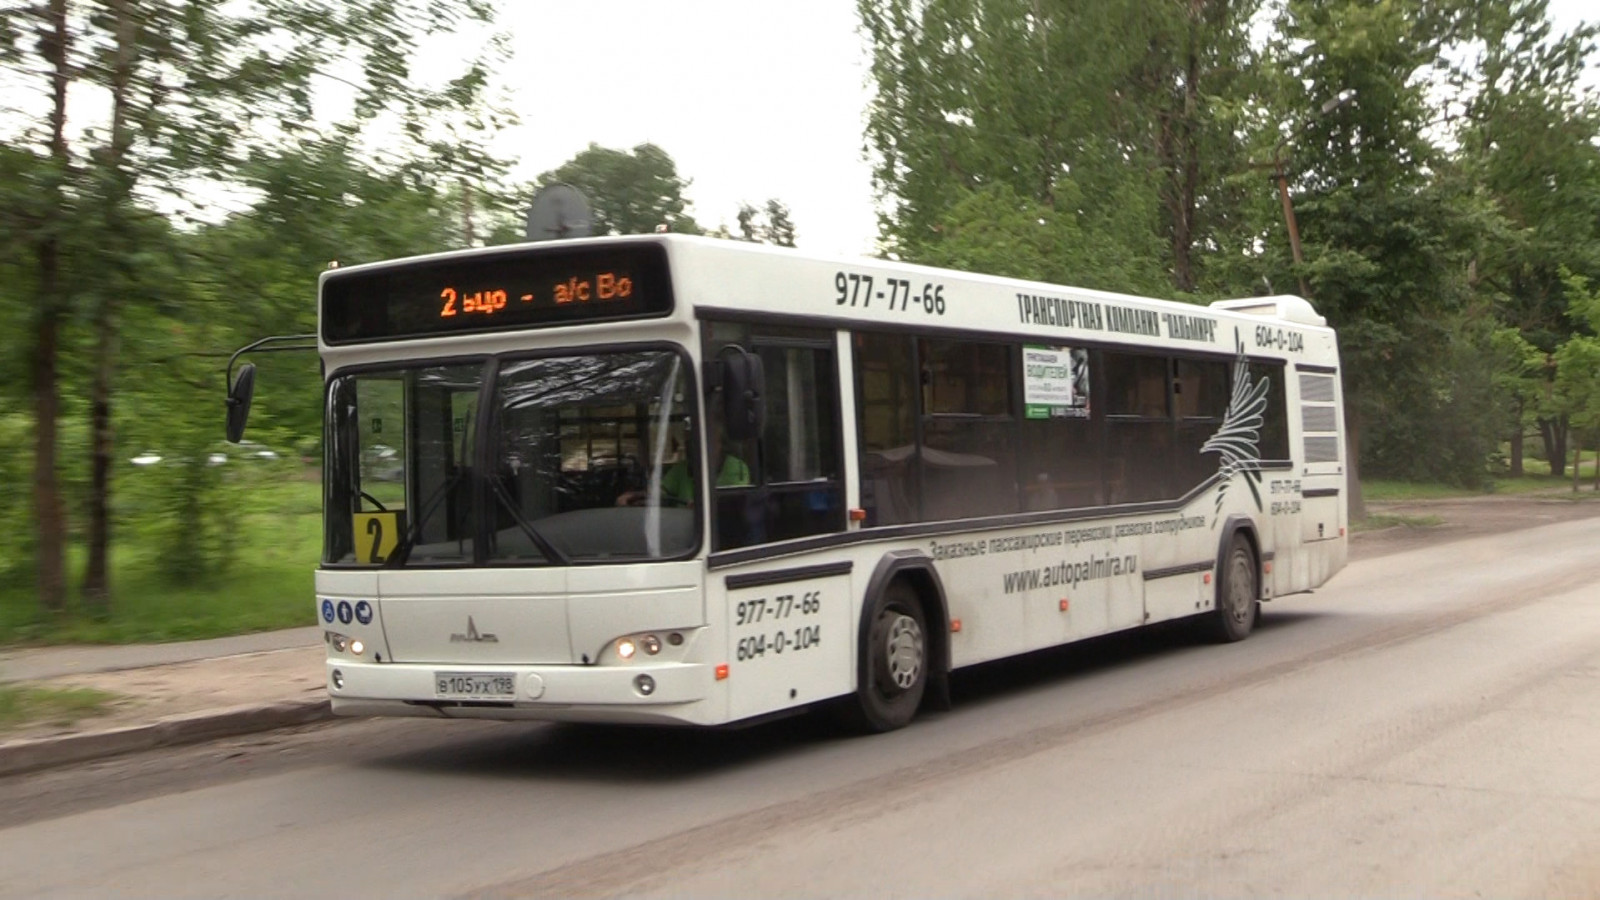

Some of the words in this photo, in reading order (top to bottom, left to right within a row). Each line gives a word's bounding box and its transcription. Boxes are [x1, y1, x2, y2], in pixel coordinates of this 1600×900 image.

[440, 287, 457, 317] 2
[835, 271, 946, 316] 977-77-66
[1016, 292, 1104, 331] ТРАНСПОРТНАЯ
[1105, 304, 1161, 337] КОМПАНИЯ
[1256, 325, 1304, 353] 604-0-104
[367, 517, 385, 563] 2
[929, 541, 987, 561] Заказные
[988, 531, 1063, 554] пассажирские
[1003, 552, 1137, 594] www.autopalmira.ru
[736, 590, 821, 626] 977-77-66
[736, 625, 821, 662] 604-0-104
